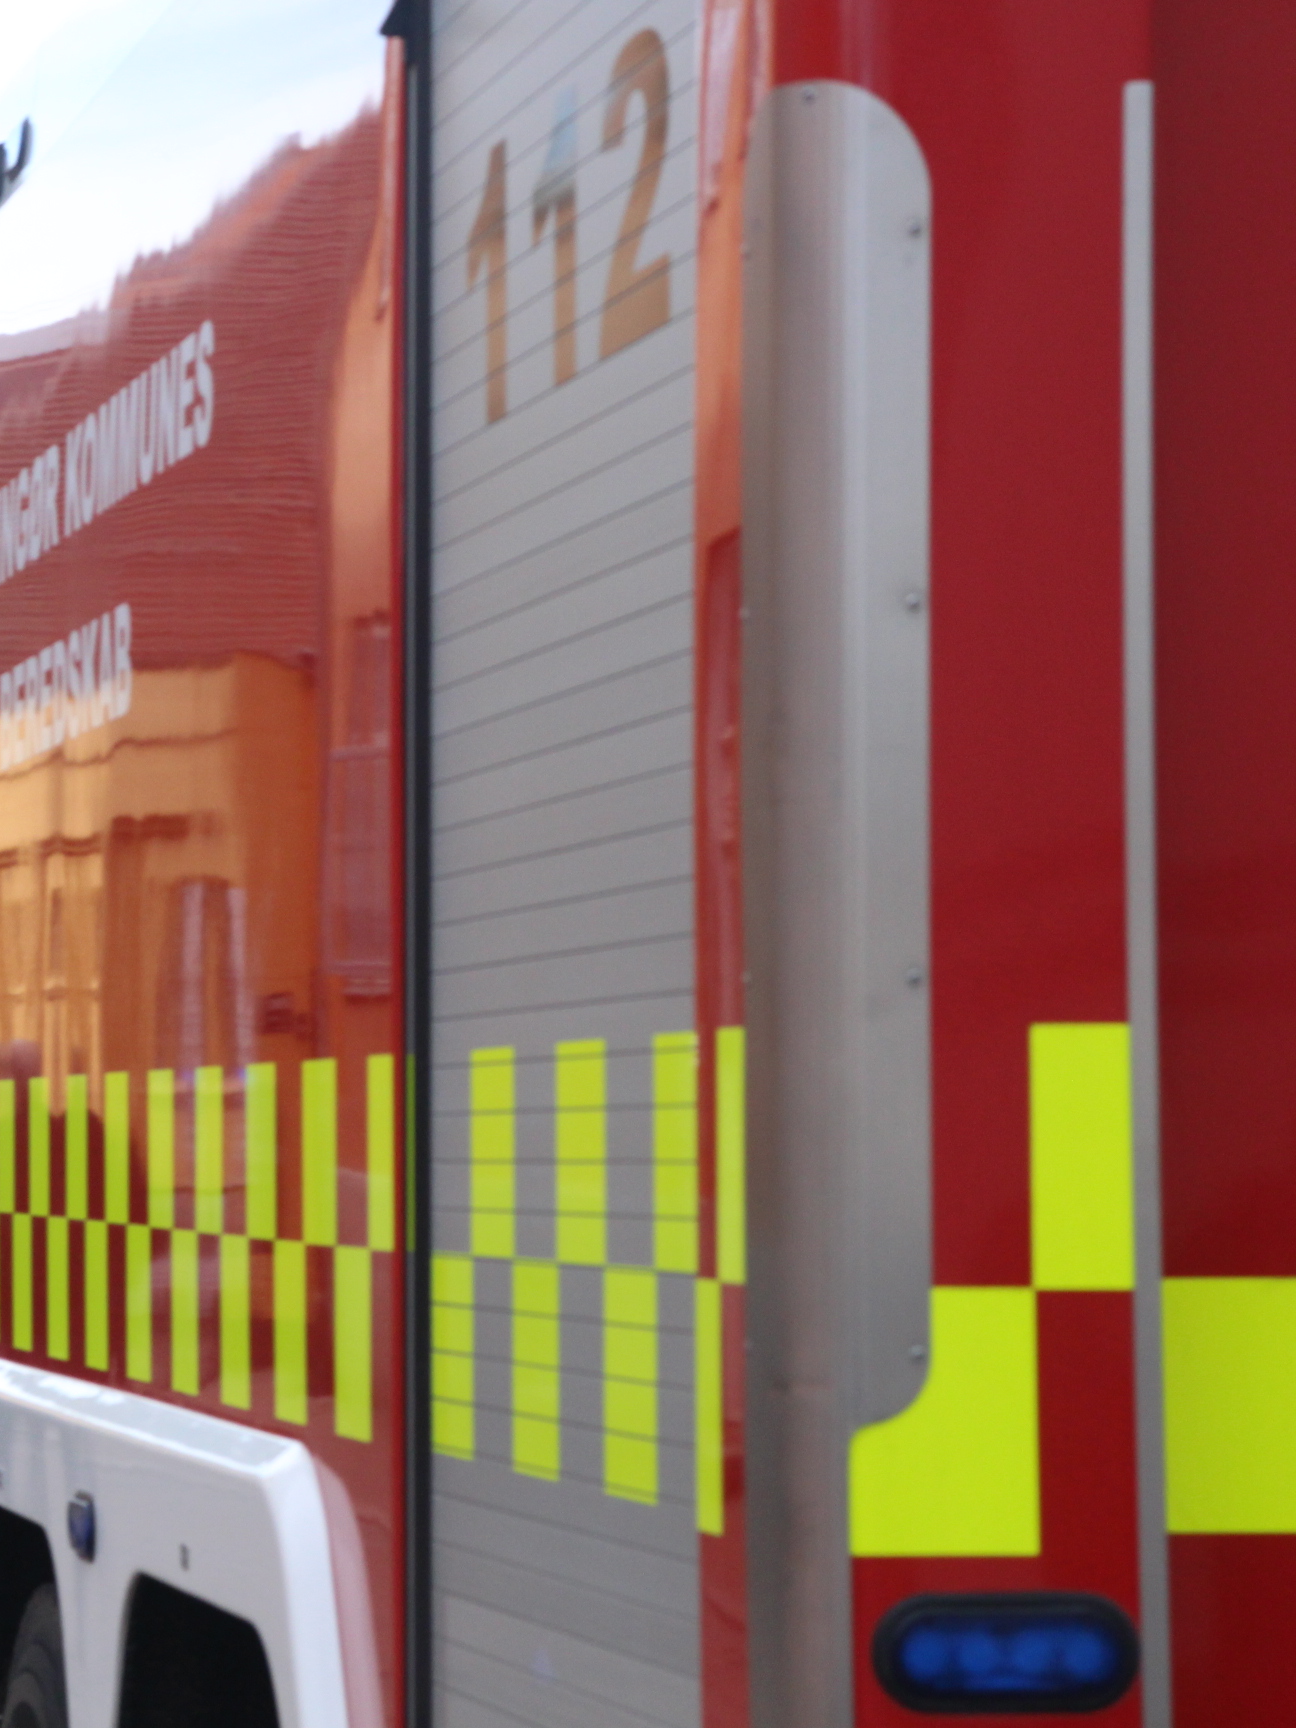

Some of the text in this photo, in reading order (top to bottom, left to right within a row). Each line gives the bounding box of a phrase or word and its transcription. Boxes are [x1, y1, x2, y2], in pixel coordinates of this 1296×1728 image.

[467, 25, 671, 426] 112
[63, 319, 215, 538] KOMMUNES
[0, 601, 134, 771] BEREDSKAB
